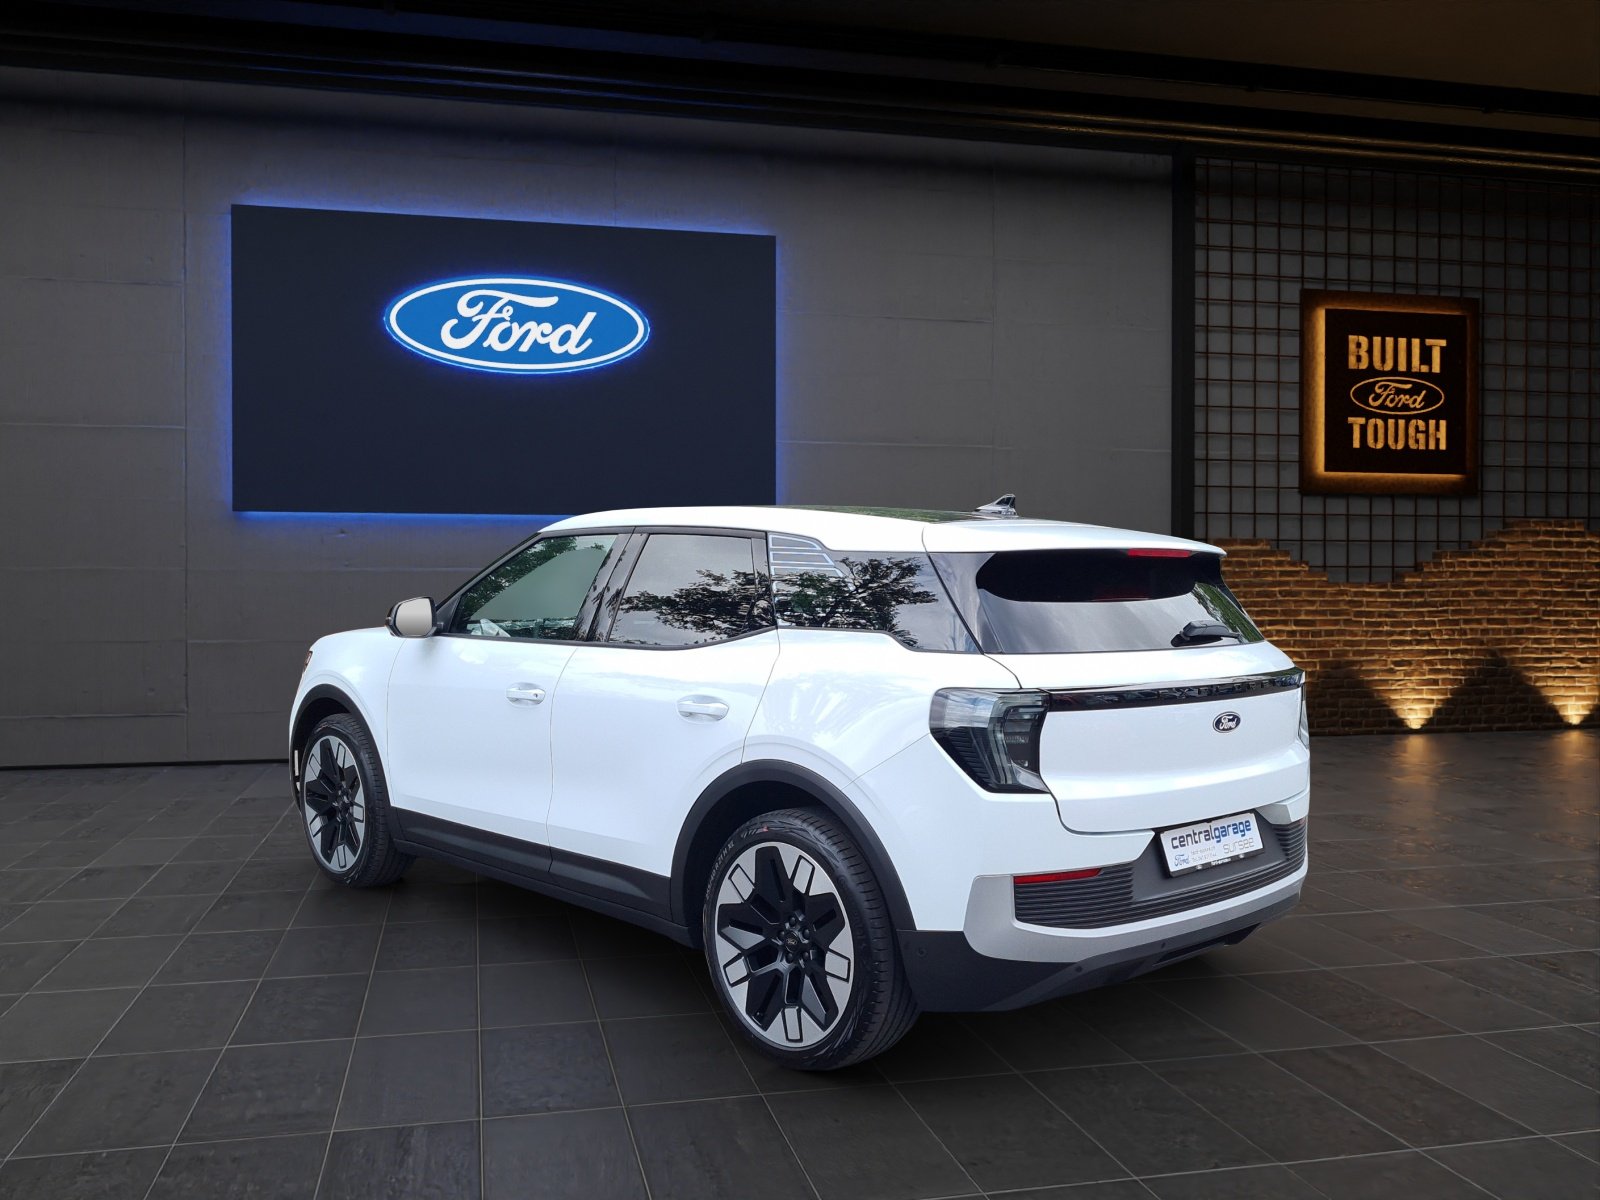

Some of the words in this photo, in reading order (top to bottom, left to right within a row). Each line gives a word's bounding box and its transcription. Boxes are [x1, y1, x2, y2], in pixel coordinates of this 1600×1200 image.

[440, 289, 597, 355] Ford
[1347, 334, 1447, 374] BUILT
[1368, 381, 1427, 409] Ford
[1347, 416, 1447, 450] TOUGH
[1218, 715, 1238, 730] Ford
[1170, 819, 1252, 849] centralgarage
